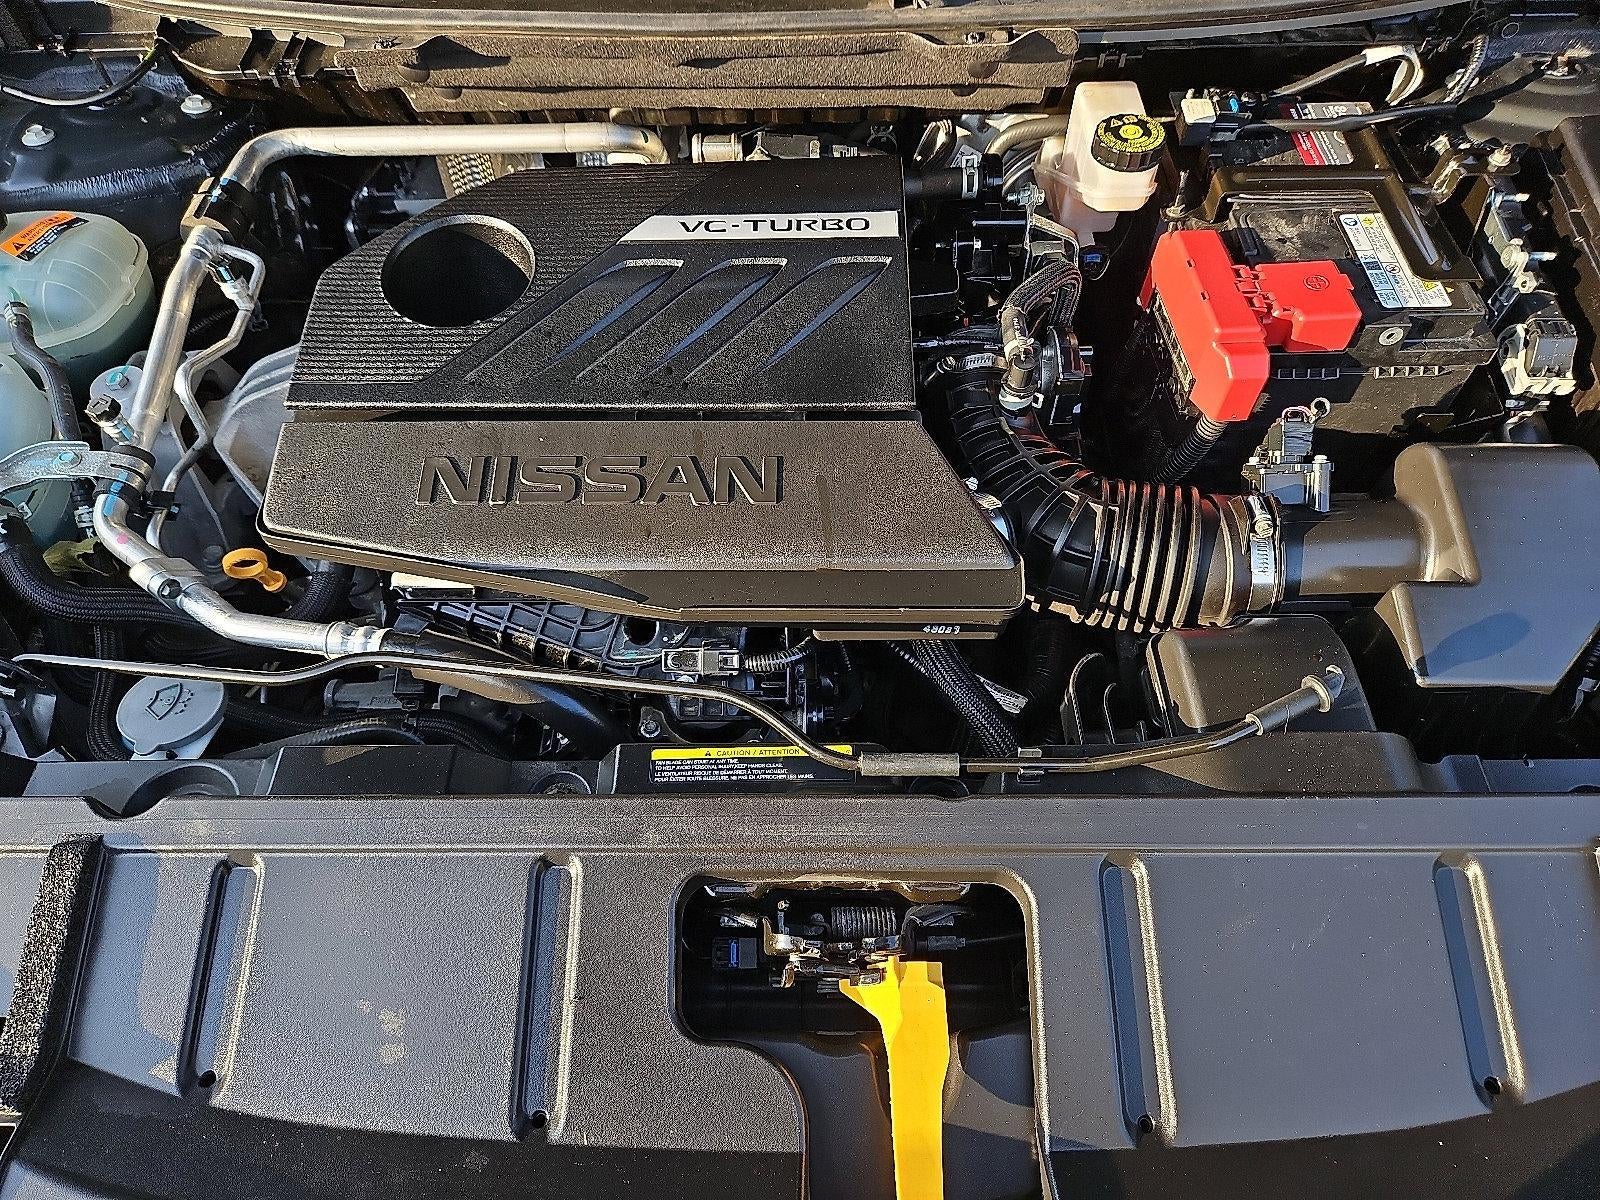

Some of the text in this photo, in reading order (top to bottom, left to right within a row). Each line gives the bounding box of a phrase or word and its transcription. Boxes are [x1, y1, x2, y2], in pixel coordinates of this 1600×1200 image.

[678, 217, 871, 233] VC-TURBO
[415, 455, 784, 506] NISSAN
[716, 749, 750, 757] CAUTION
[758, 748, 800, 756] ATTENTION
